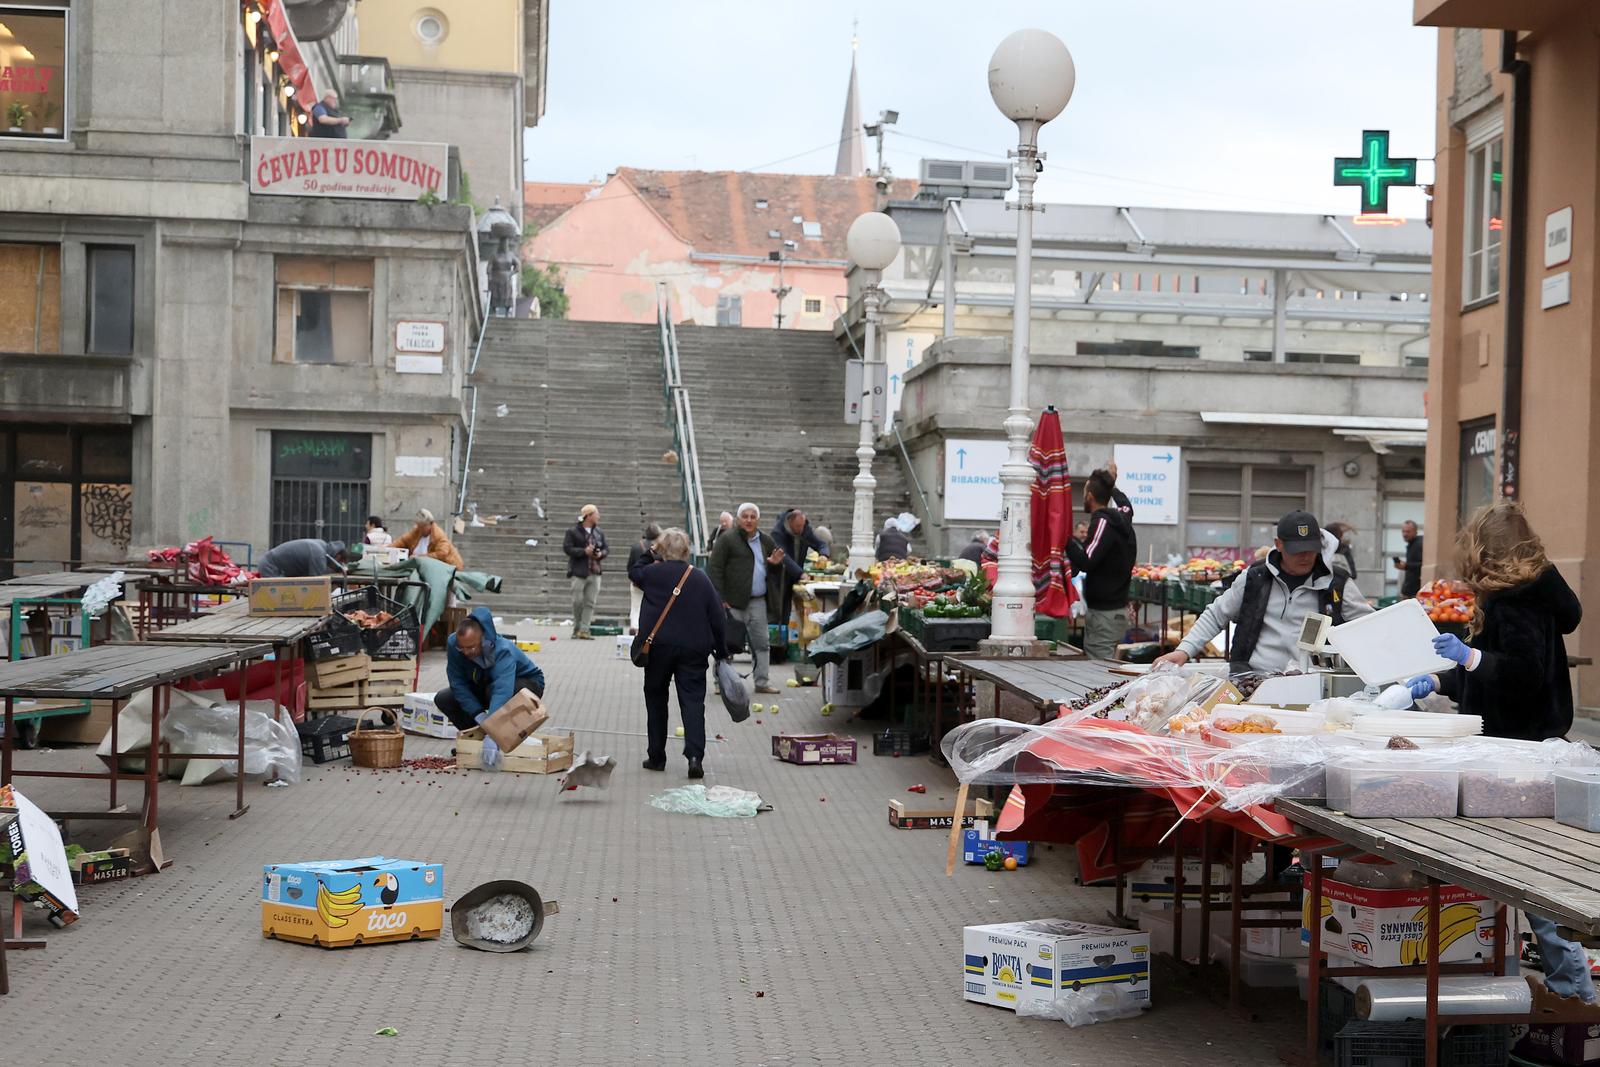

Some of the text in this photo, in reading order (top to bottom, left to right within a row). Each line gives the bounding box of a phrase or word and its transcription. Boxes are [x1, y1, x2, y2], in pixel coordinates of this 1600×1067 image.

[334, 148, 348, 173] U
[354, 148, 442, 191] SOMUNU
[303, 179, 318, 191] 50
[951, 475, 1001, 485] RIBARNIC
[1126, 472, 1167, 481] MLIJEKO
[1137, 485, 1153, 493] SIR
[929, 817, 975, 826] MASER
[93, 868, 127, 881] MASTER
[273, 913, 292, 923] CLASS
[293, 916, 314, 926] EXTRA
[367, 910, 407, 931] toco
[1380, 921, 1424, 934] BANANAS
[1380, 932, 1423, 941] Class Extra
[1479, 929, 1496, 940] ole
[988, 935, 1028, 948] PREMIUM PACK
[1081, 940, 1129, 951] PREMIUM PACK
[1351, 942, 1369, 954] Dole
[992, 952, 1023, 981] BONITA
